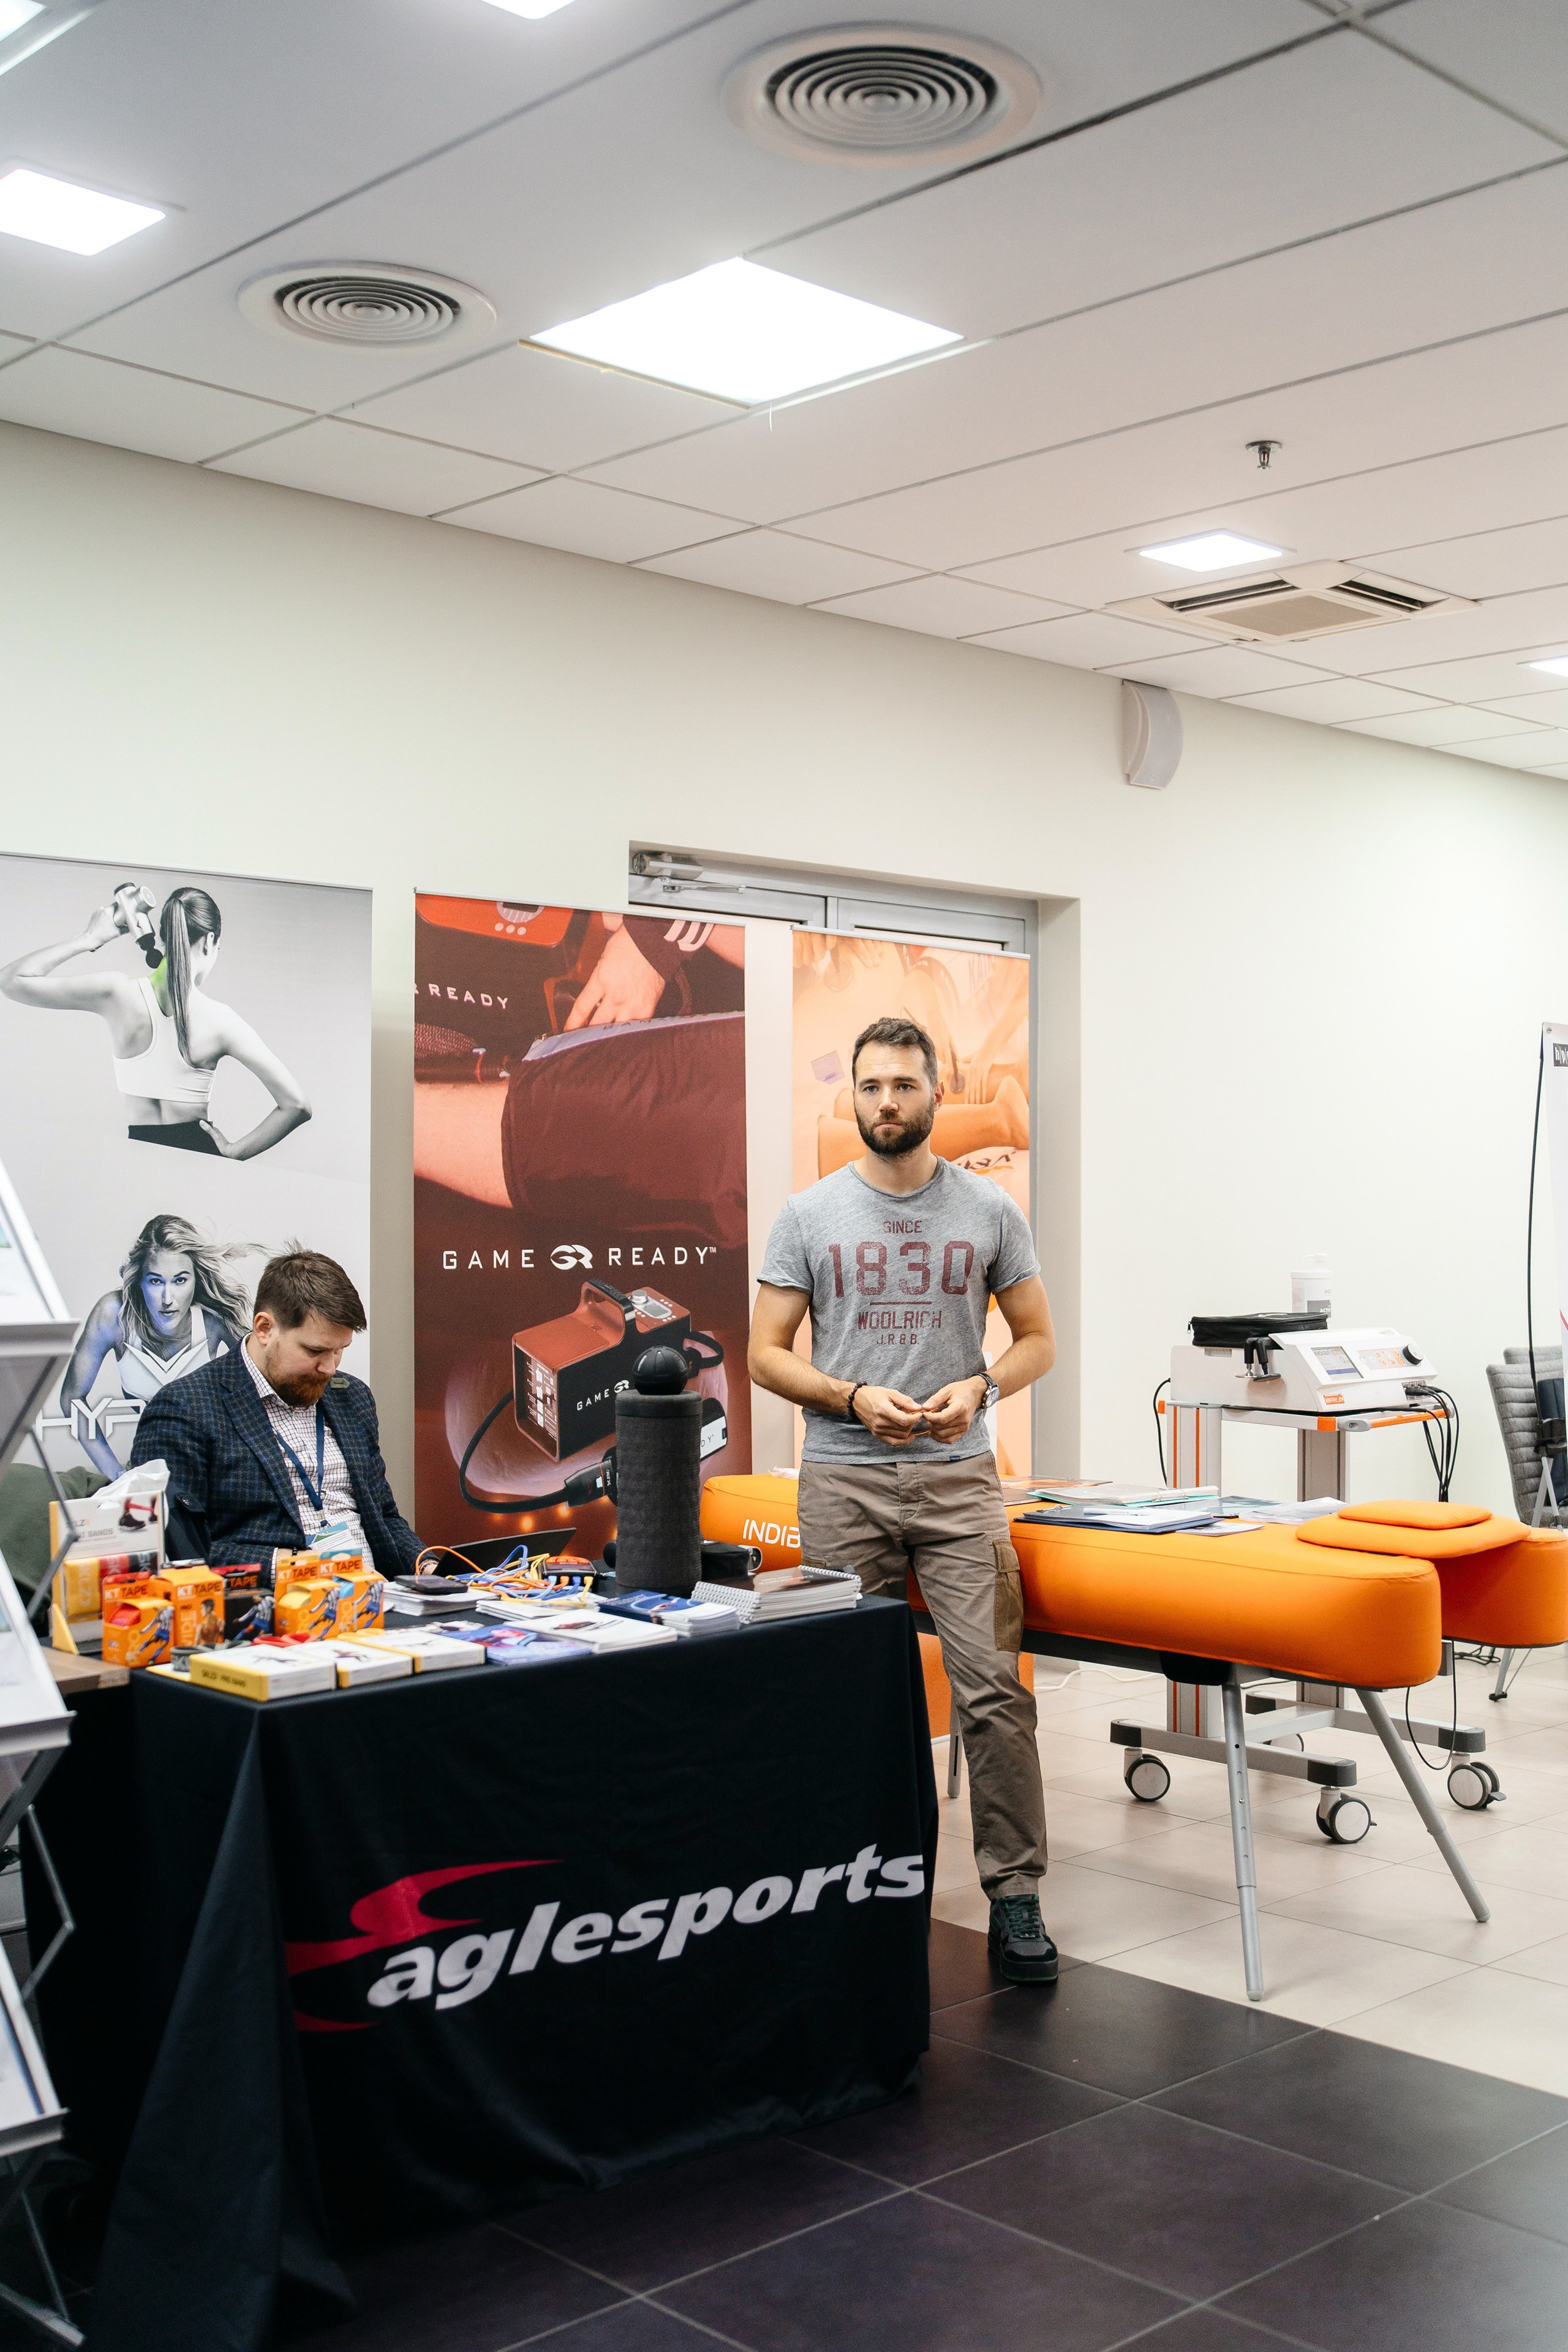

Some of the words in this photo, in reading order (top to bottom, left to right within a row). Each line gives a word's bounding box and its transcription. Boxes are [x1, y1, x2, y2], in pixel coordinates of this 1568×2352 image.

[428, 983, 508, 1009] READY
[883, 1220, 923, 1234] SINCE
[443, 1249, 534, 1270] GAME
[828, 1240, 974, 1298] 1830
[858, 1310, 942, 1330] WOOLRICH
[576, 1389, 609, 1411] GAME
[277, 1570, 292, 1581] KT
[293, 1567, 317, 1578] TAPE
[320, 1562, 334, 1573] KT
[334, 1560, 360, 1572] TAPE
[177, 1585, 194, 1597] KT
[194, 1579, 221, 1594] TAPE
[229, 1576, 258, 1588] TAPE
[104, 1588, 121, 1600] KT
[121, 1584, 148, 1597] TAPE
